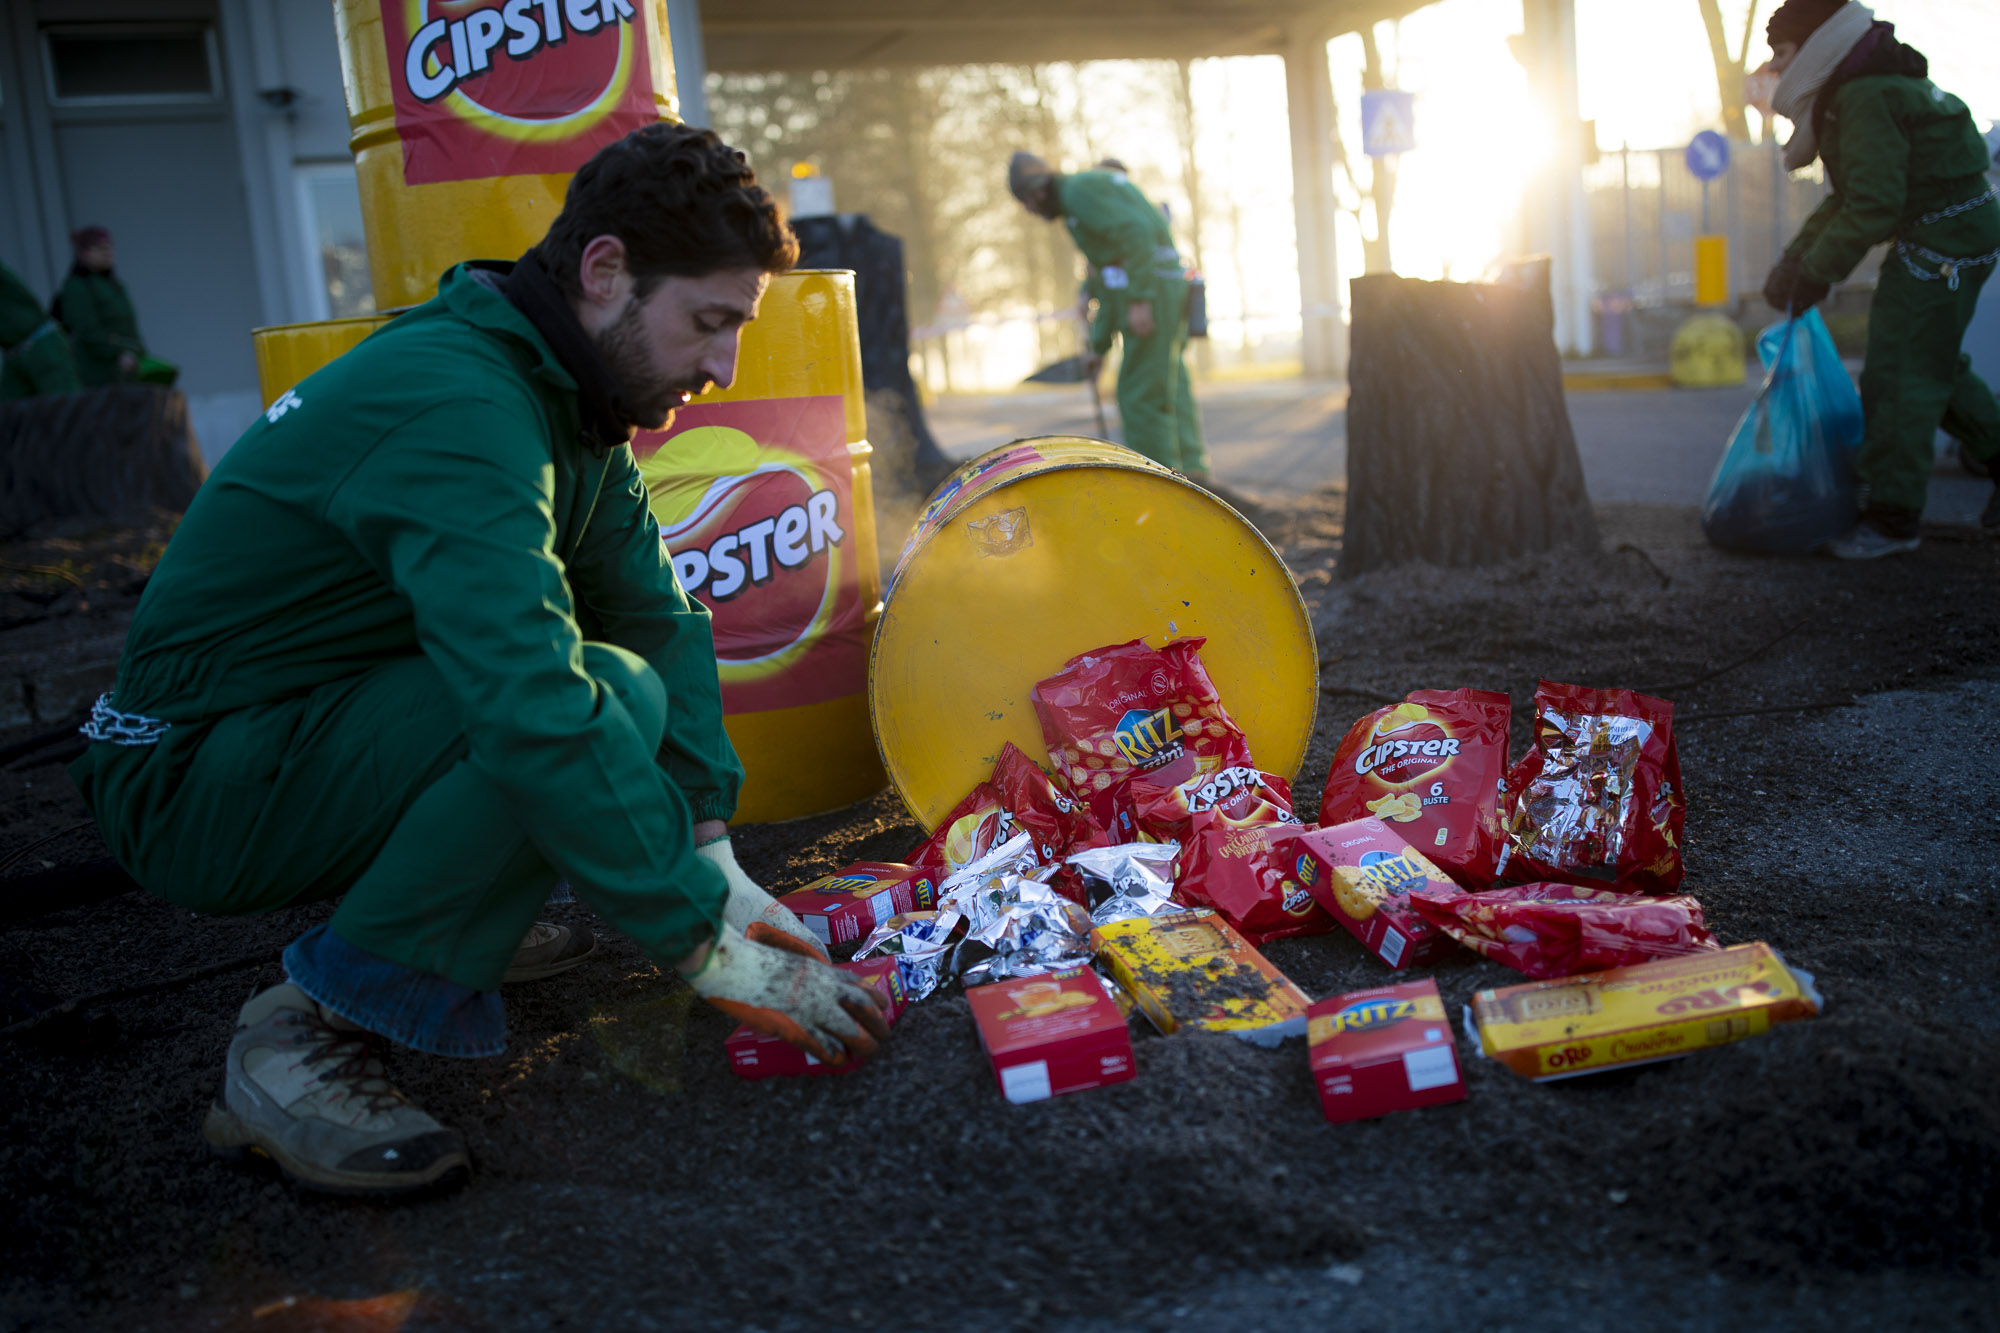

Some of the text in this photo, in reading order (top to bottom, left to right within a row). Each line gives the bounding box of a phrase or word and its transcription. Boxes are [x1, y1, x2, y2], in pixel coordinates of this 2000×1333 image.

[671, 488, 846, 602] PSTER
[1108, 689, 1147, 710] ORIGINAL
[1112, 706, 1185, 766] RITZ
[1354, 737, 1461, 776] CIPSTER
[1380, 757, 1438, 776] THE ORIGINAL
[1422, 796, 1450, 806] BUSTE
[1430, 781, 1444, 797] 6
[1041, 843, 1053, 860] 6
[1341, 835, 1376, 848] ORIGINAL
[1297, 853, 1317, 886] RITZ
[1363, 855, 1426, 892] RITZ
[814, 877, 879, 892] RITZ
[915, 879, 932, 909] RITZ
[1335, 1000, 1415, 1034] RITZ
